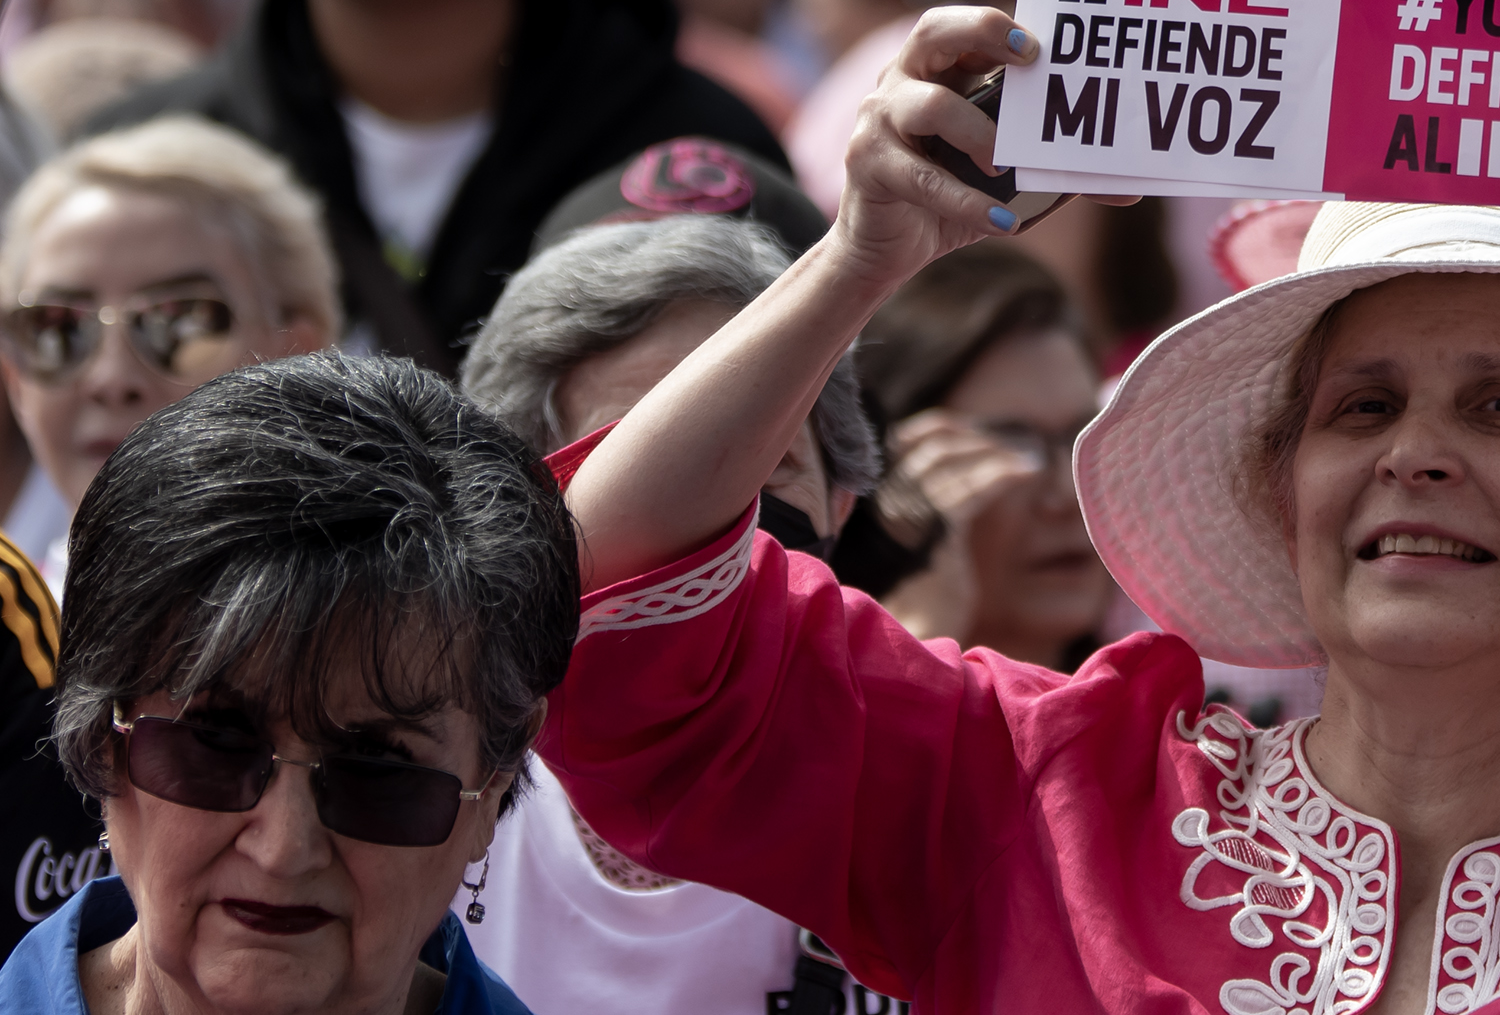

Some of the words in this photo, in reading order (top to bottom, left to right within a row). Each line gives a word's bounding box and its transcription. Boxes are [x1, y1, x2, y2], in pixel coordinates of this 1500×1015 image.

[1049, 12, 1287, 81] DEFIENDE
[1041, 74, 1121, 147] MI
[1146, 81, 1281, 160] VOZ
